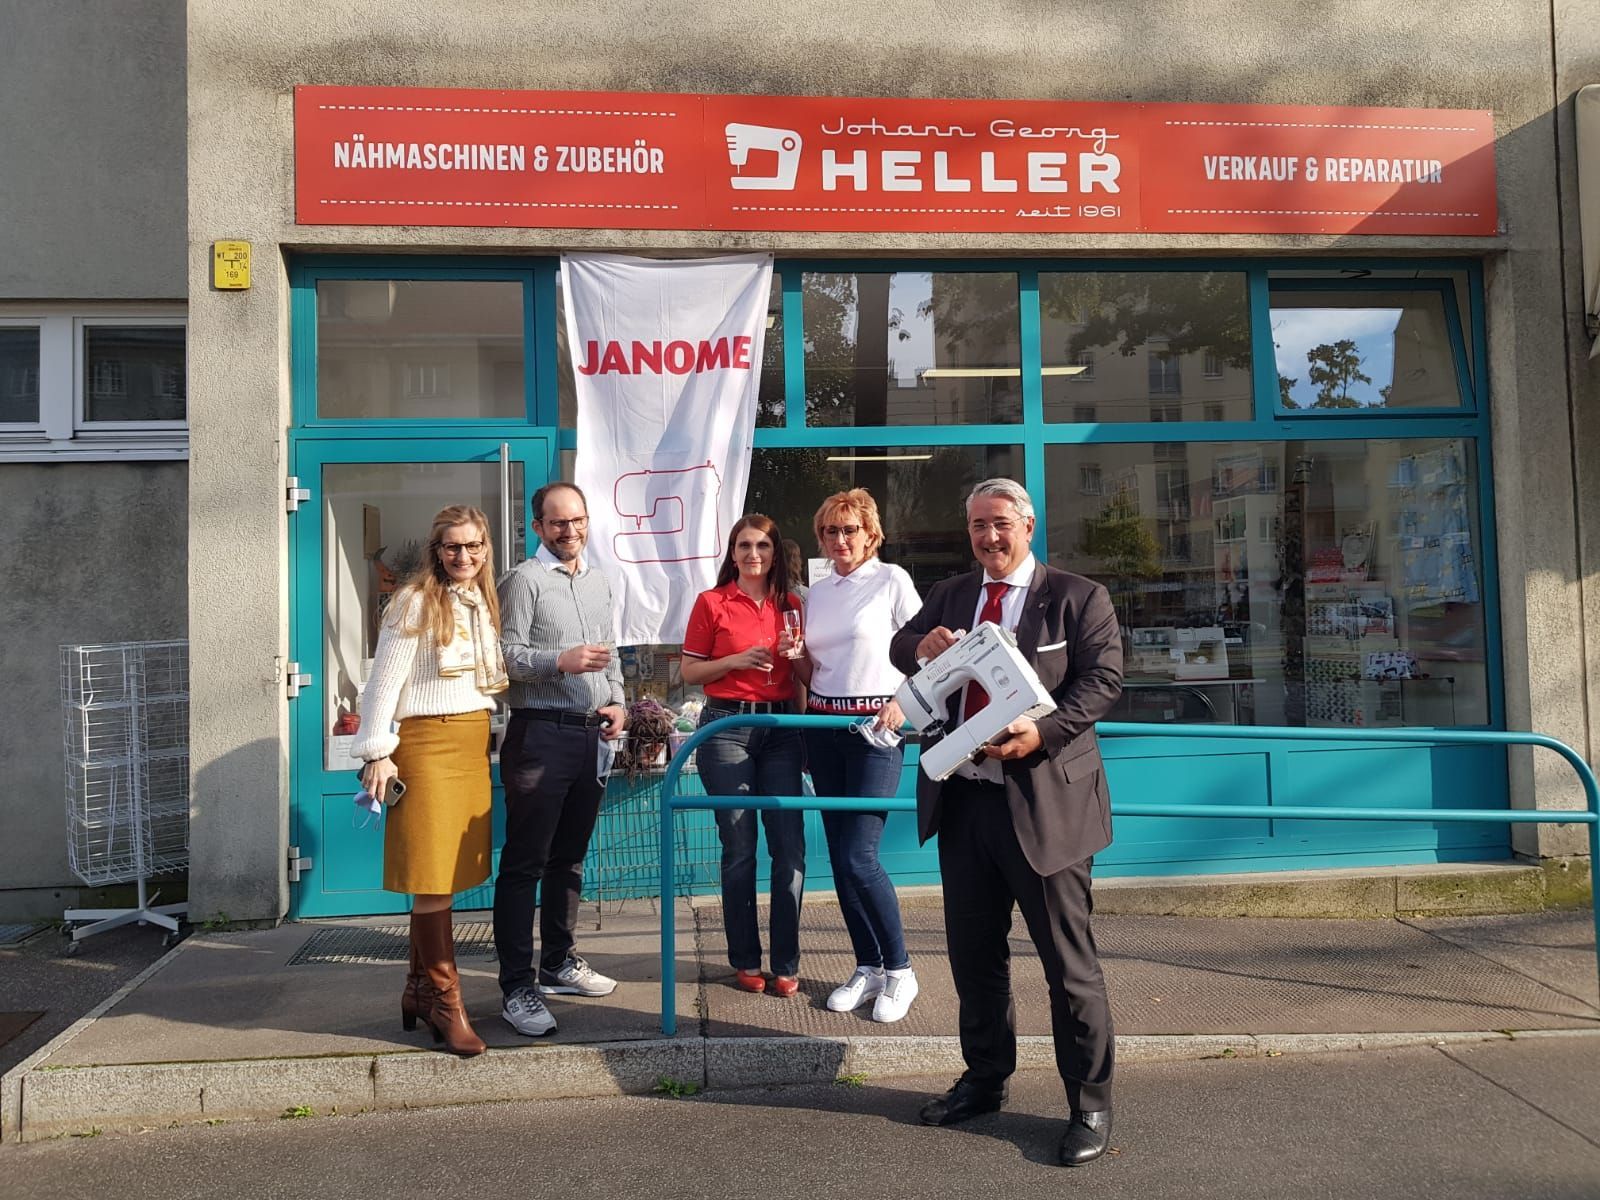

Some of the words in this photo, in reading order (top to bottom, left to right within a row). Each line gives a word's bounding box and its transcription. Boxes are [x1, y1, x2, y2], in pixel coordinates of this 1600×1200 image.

[334, 133, 526, 171] NÄHMASCHINEN
[533, 145, 549, 172] &
[555, 139, 664, 174] ZUBEHÖR
[821, 116, 977, 137] Johann
[989, 119, 1120, 154] Georg
[821, 149, 1121, 194] HELLER
[1203, 155, 1299, 182] VERKAUF
[1305, 156, 1320, 182] &
[1325, 157, 1443, 184] REPARATUR
[1015, 205, 1072, 218] seit
[1078, 205, 1122, 218] 1961
[577, 335, 752, 376] JANOME
